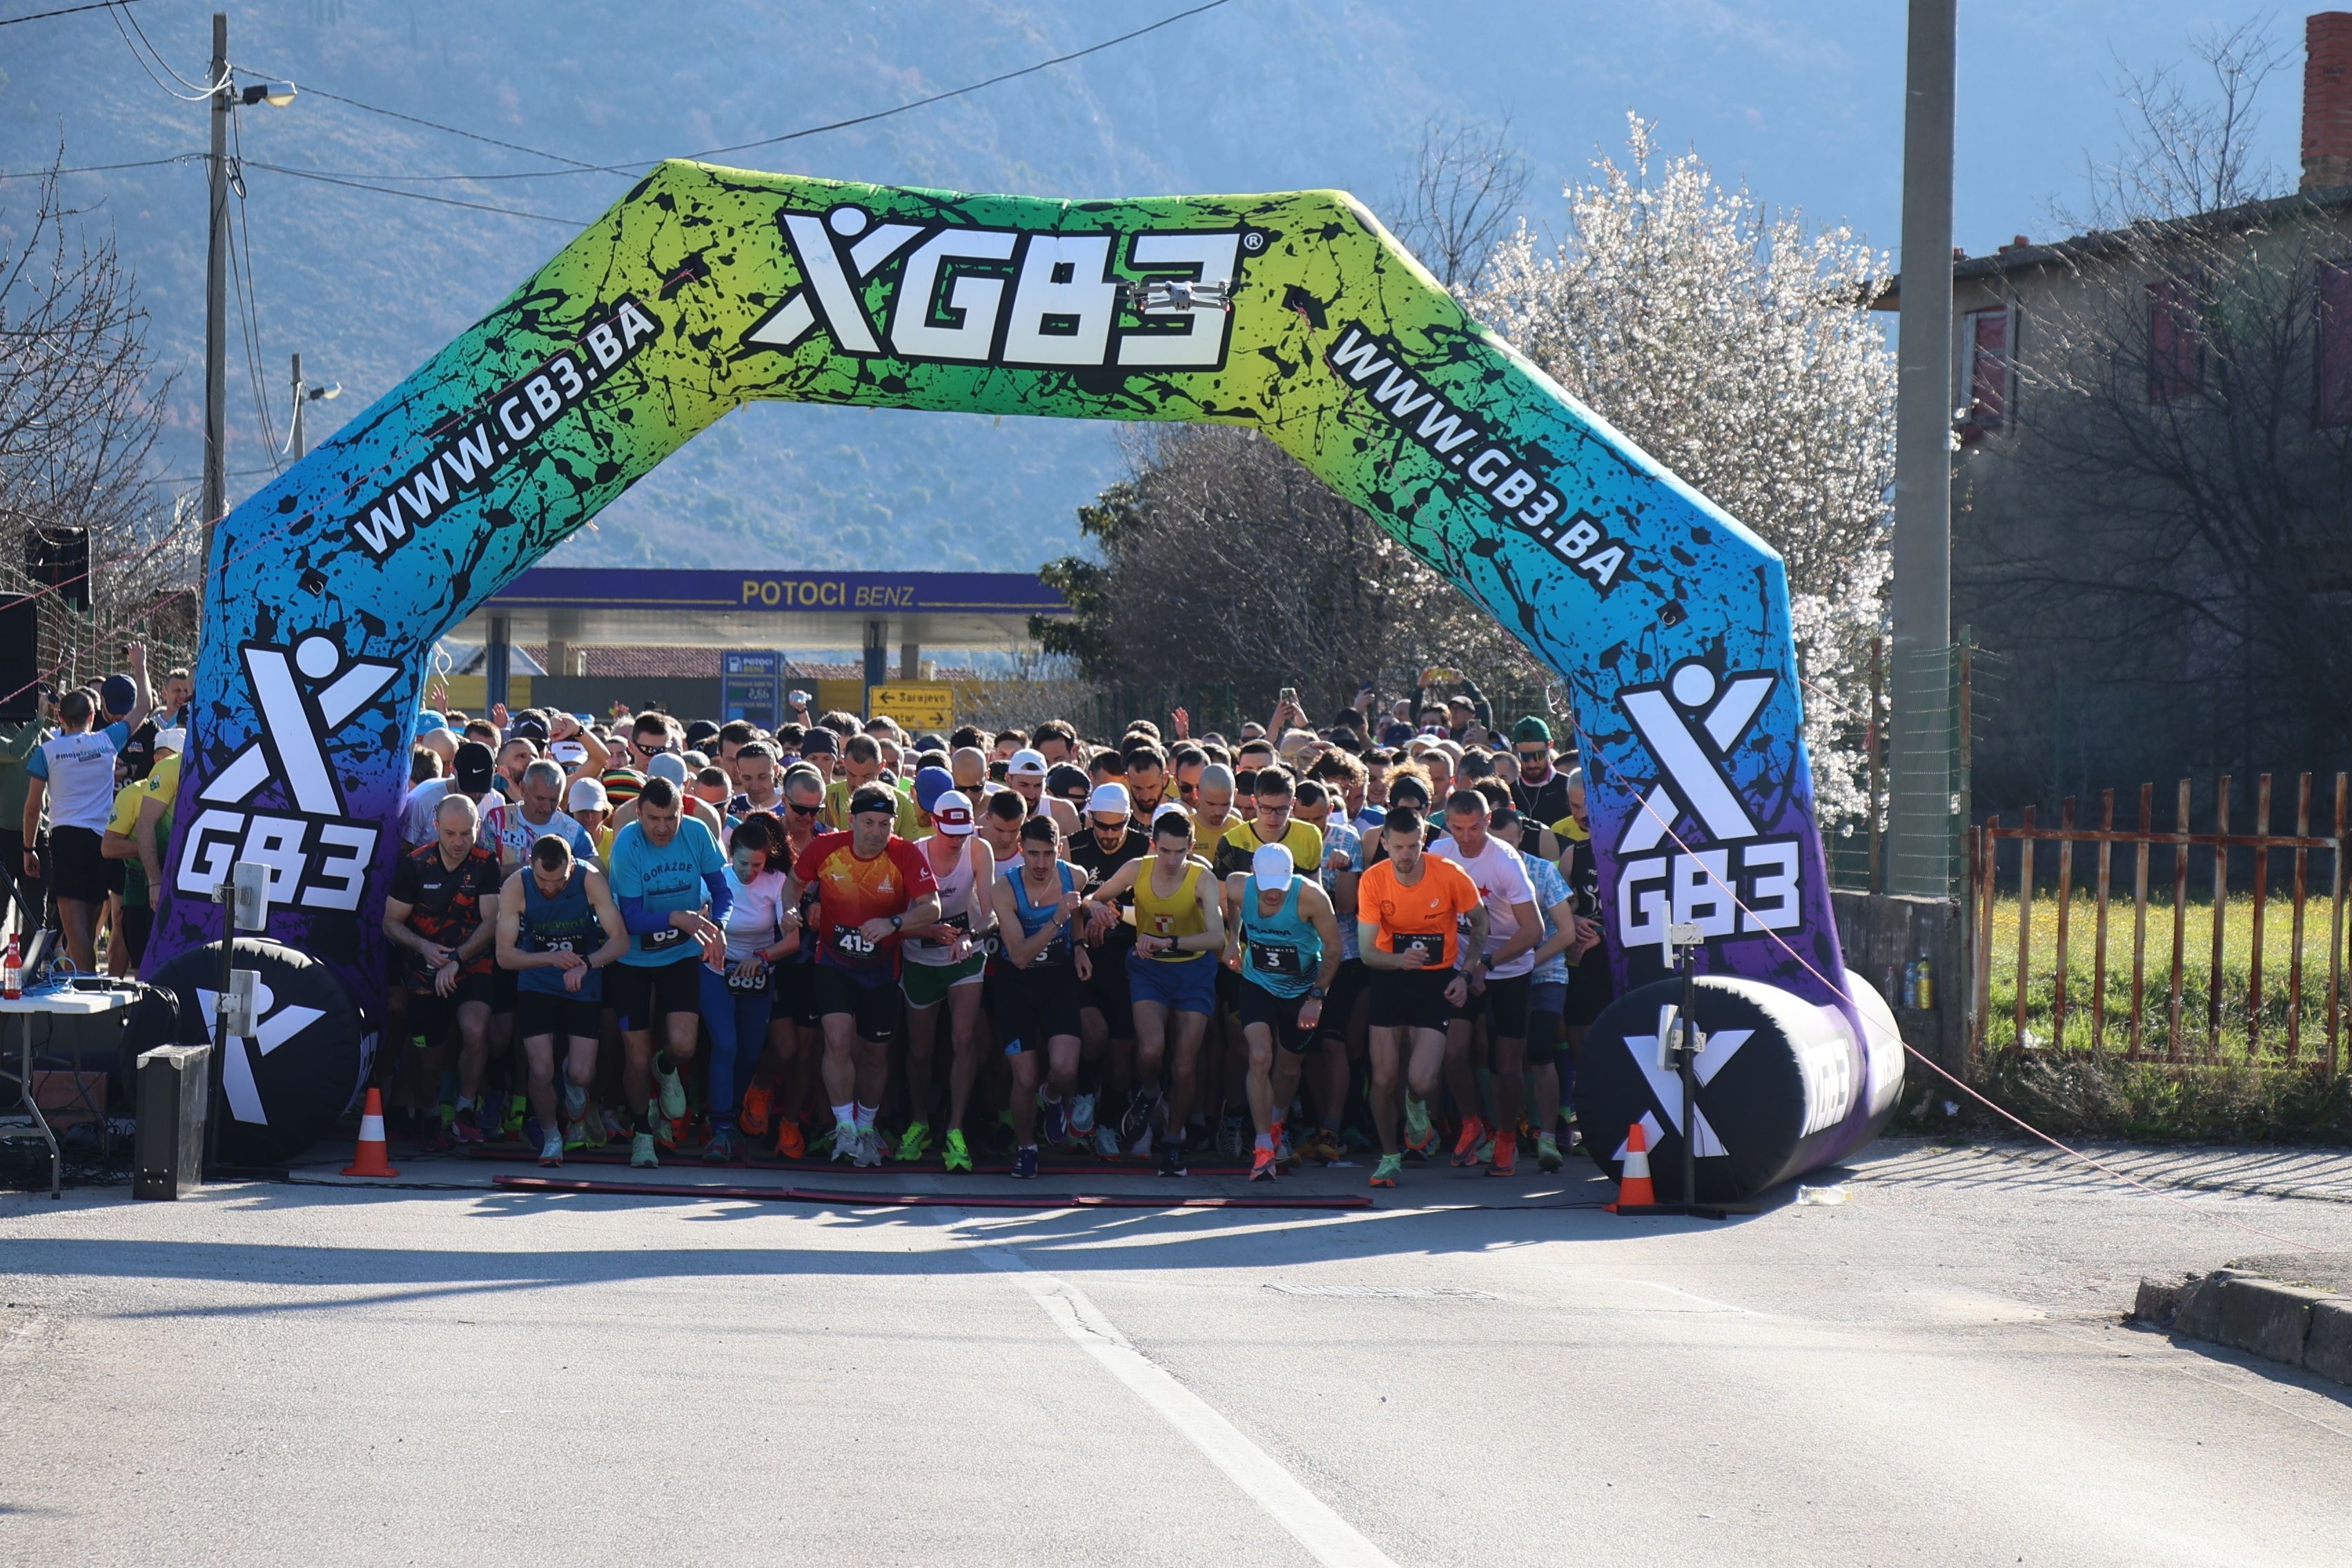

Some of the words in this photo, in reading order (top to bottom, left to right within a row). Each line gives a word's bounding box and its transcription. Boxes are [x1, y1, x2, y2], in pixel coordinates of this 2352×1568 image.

[353, 301, 655, 554] WWW.GB3.BA
[1332, 329, 1626, 587] WWW.GB3.BA
[743, 580, 845, 606] POTOCI
[854, 587, 914, 607] BENZ
[899, 692, 946, 704] Sarajevo
[177, 809, 378, 912] GB3
[1618, 841, 1800, 948] GB3
[1266, 952, 1280, 967] 3
